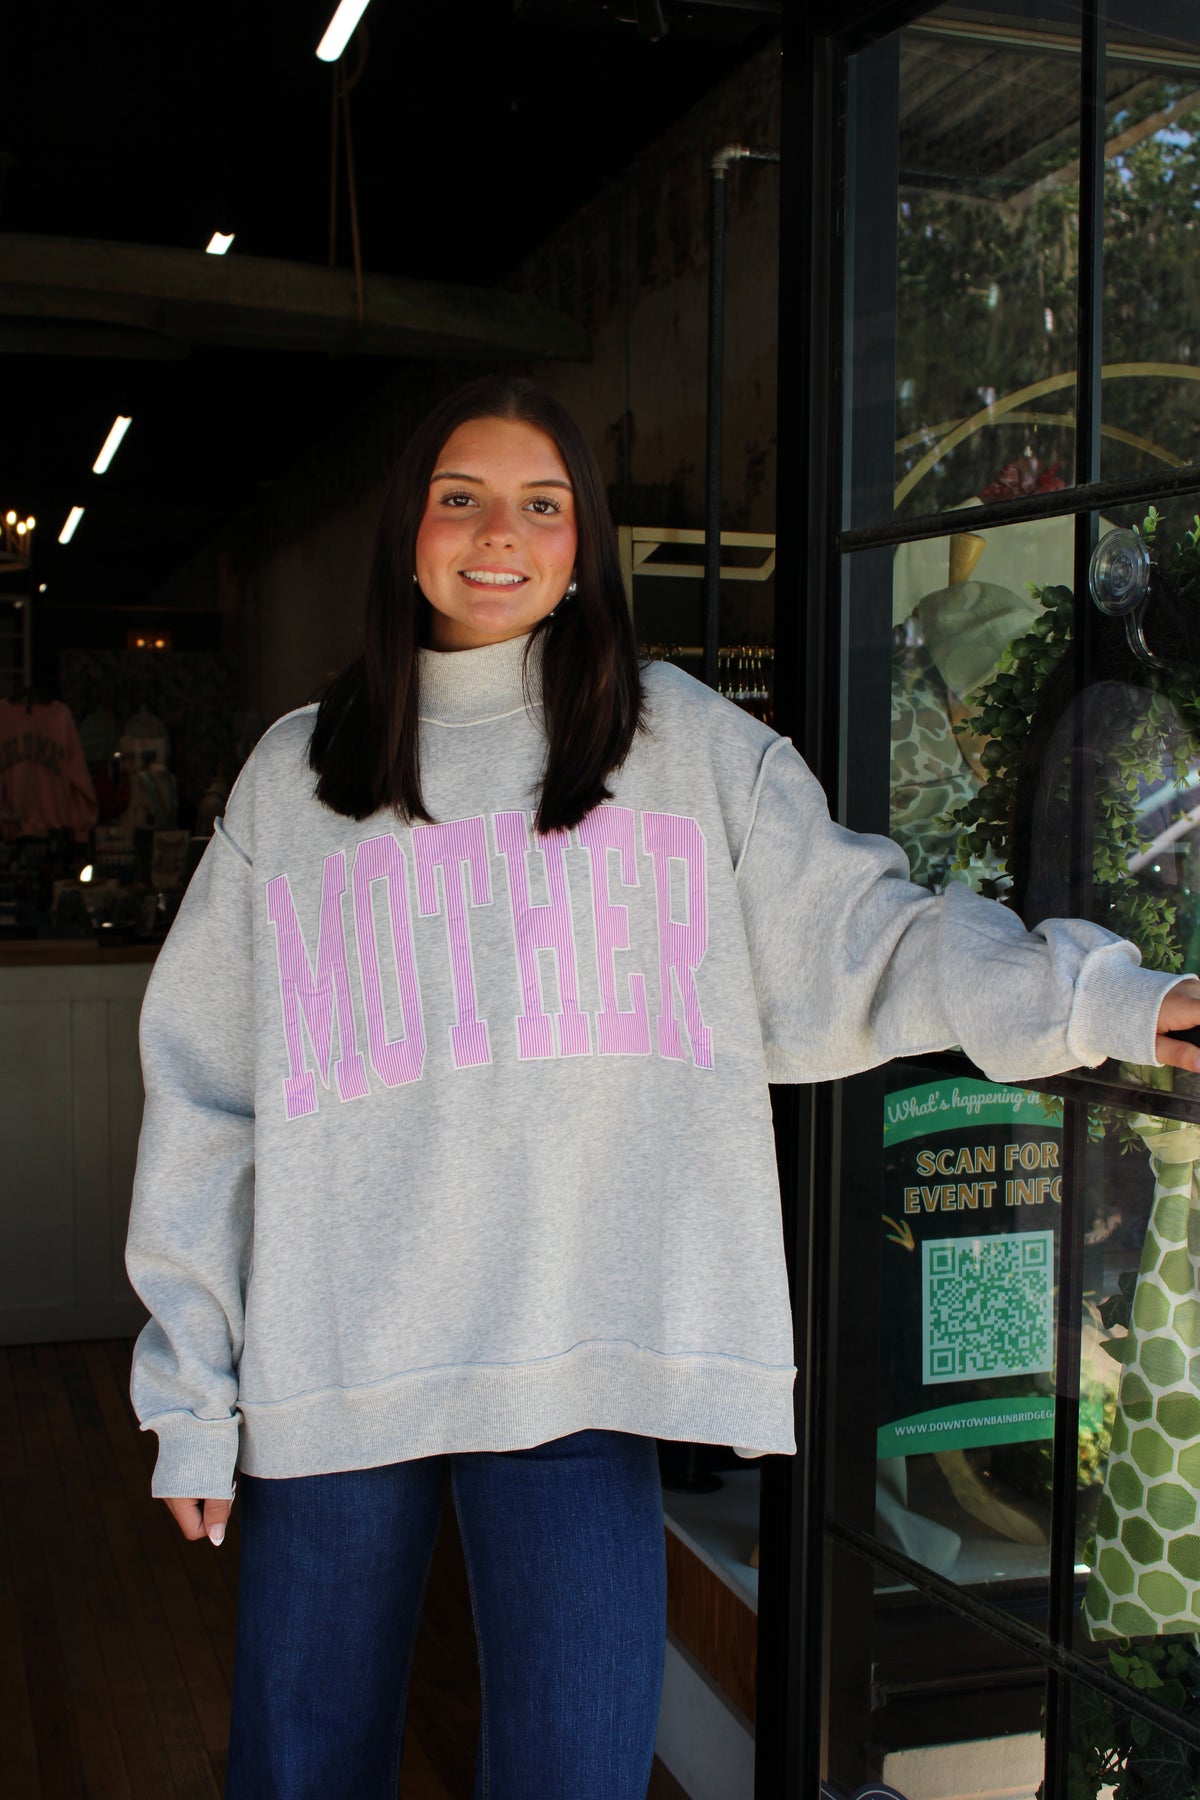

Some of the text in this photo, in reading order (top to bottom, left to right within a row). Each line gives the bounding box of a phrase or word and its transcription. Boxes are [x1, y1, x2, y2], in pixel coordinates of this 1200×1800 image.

[265, 805, 715, 1121] MOTHER
[887, 1090, 951, 1124] What's
[951, 1087, 1025, 1115] happening
[916, 1142, 1060, 1177] SCAN FOR
[903, 1180, 997, 1214] EVENT
